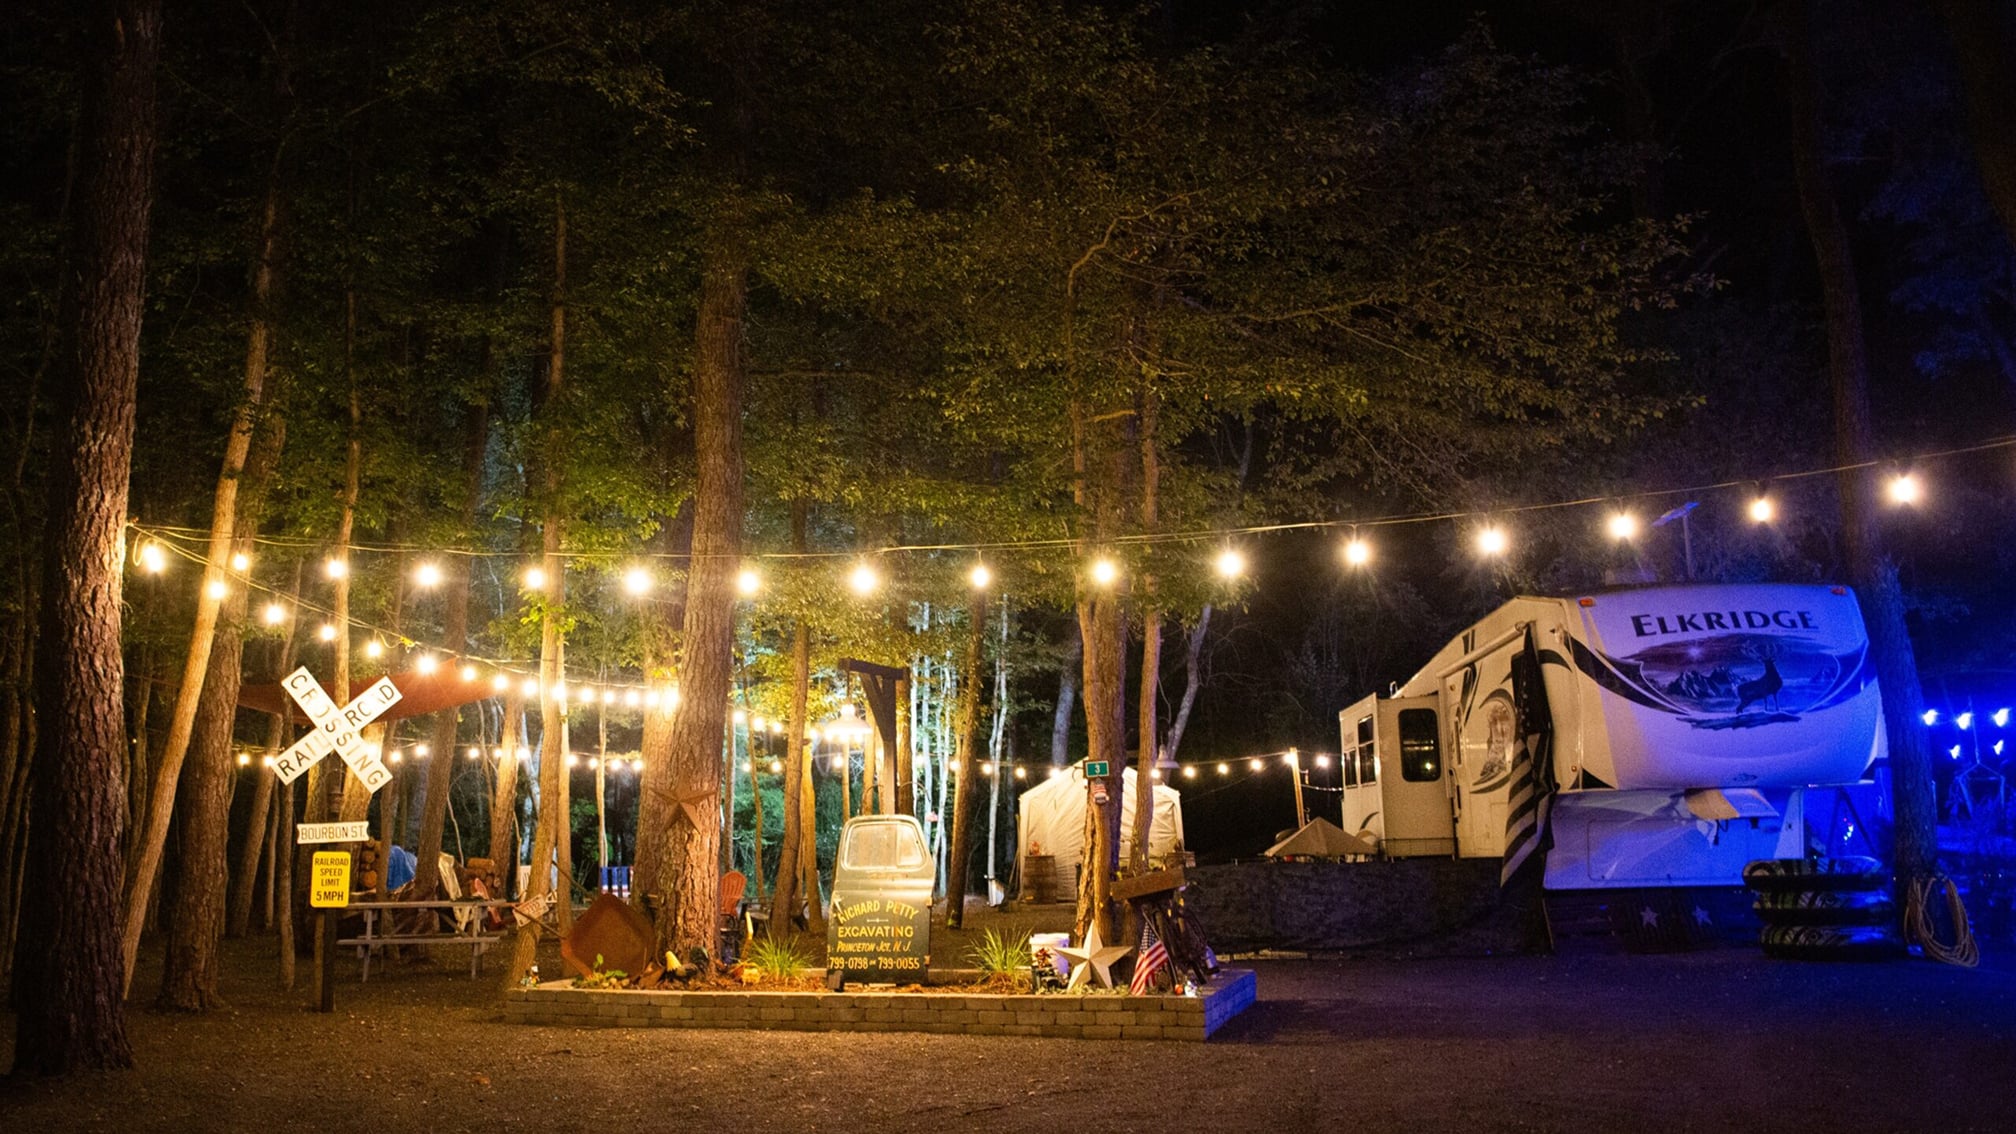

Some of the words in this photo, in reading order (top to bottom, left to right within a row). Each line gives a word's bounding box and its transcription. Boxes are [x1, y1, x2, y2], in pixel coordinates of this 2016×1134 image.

[1631, 610, 1819, 637] ELKRIDGE
[1094, 764, 1101, 774] 3
[300, 826, 349, 841] BOURBON
[314, 857, 350, 867] RAILROAD
[319, 867, 343, 877] SPEED
[320, 878, 341, 887] LIMIT
[315, 890, 323, 902] 5
[323, 890, 345, 901] MPH
[838, 900, 880, 923] RICHARD
[886, 900, 919, 919] PETTY
[838, 926, 913, 937] EXCAVATING
[837, 941, 876, 952] PRINCETON
[830, 957, 868, 969] 799-0798
[878, 957, 919, 969] 799-0055
